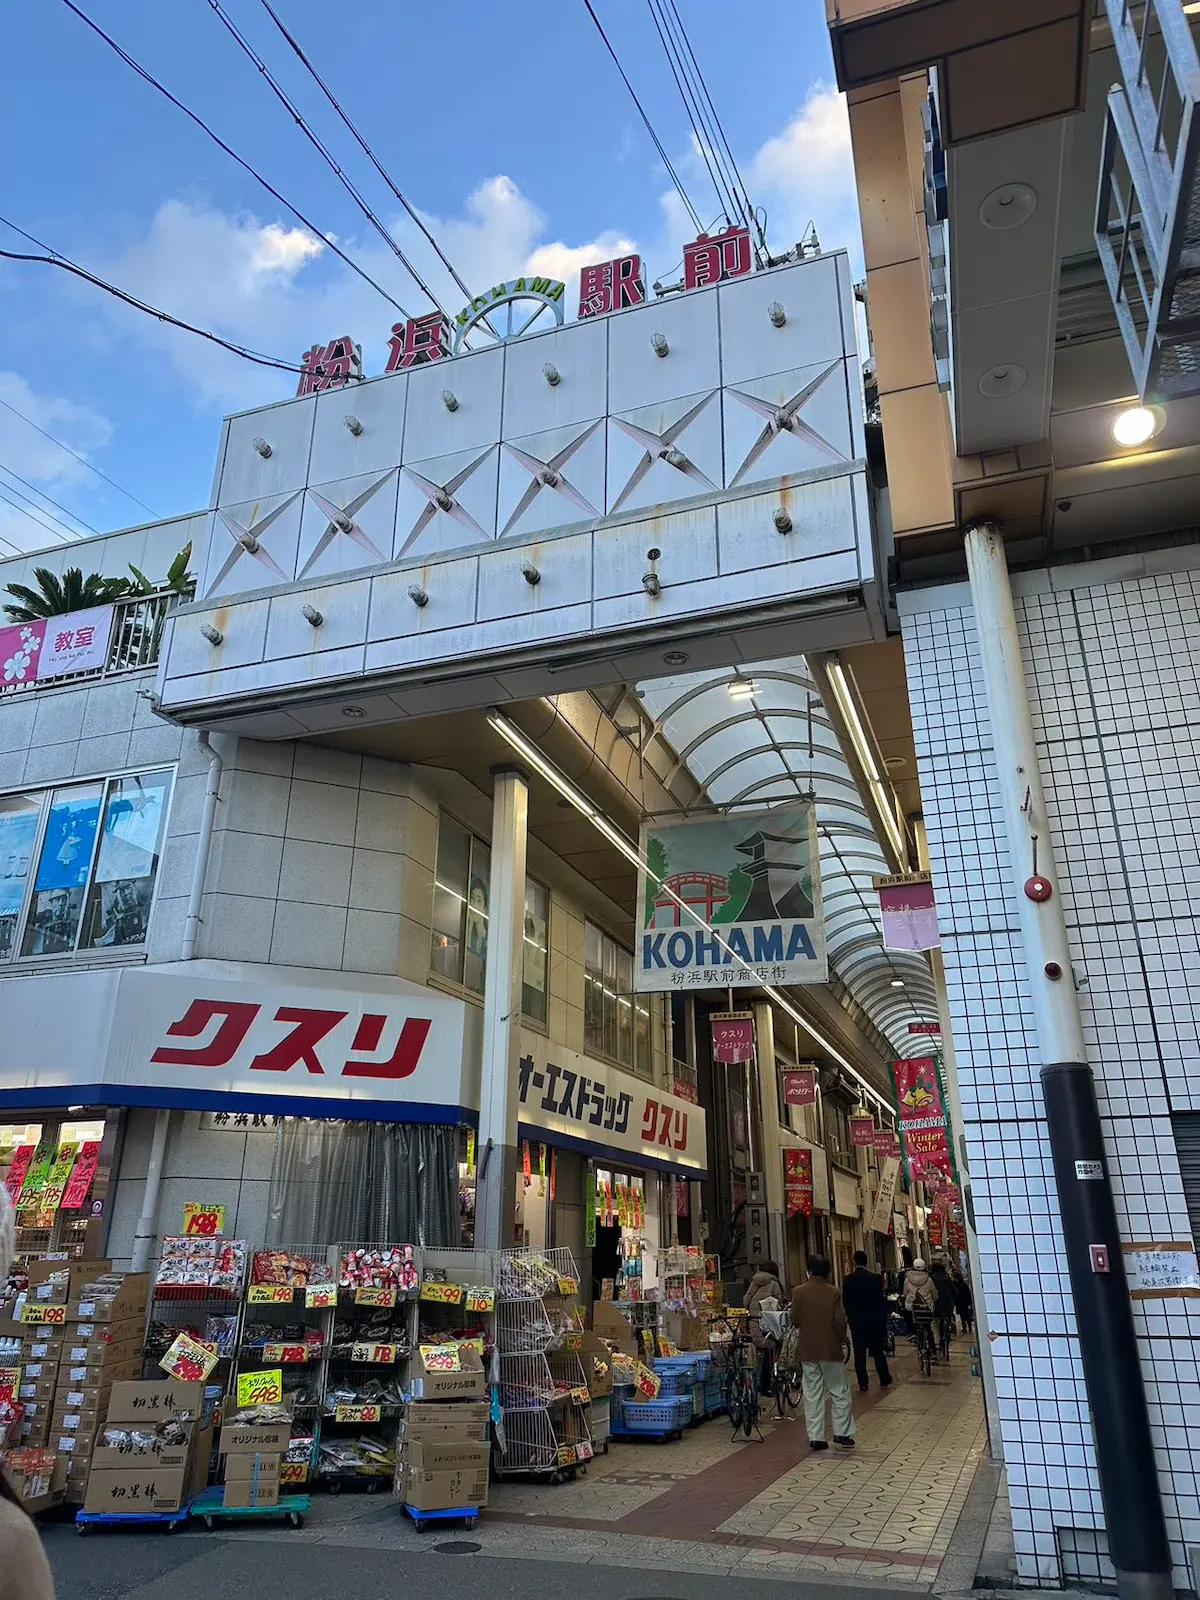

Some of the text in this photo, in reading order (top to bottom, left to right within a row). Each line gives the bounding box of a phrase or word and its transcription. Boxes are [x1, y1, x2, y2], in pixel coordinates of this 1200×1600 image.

[455, 275, 565, 326] KOHAMA
[54, 626, 95, 652] 教室
[643, 923, 818, 970] KOHAMA
[671, 966, 787, 985] 粉浜駅前商店街
[150, 999, 433, 1080] クスリ
[518, 1054, 688, 1152] オーエスドラッグ クスリ
[907, 1132, 943, 1143] Winter
[915, 1141, 938, 1153] Sale
[186, 1213, 218, 1234] 198
[271, 1286, 292, 1301] 198
[443, 1288, 460, 1303] 99
[43, 1307, 64, 1323] 198
[427, 1357, 454, 1369] 298
[286, 1465, 303, 1480] 99
